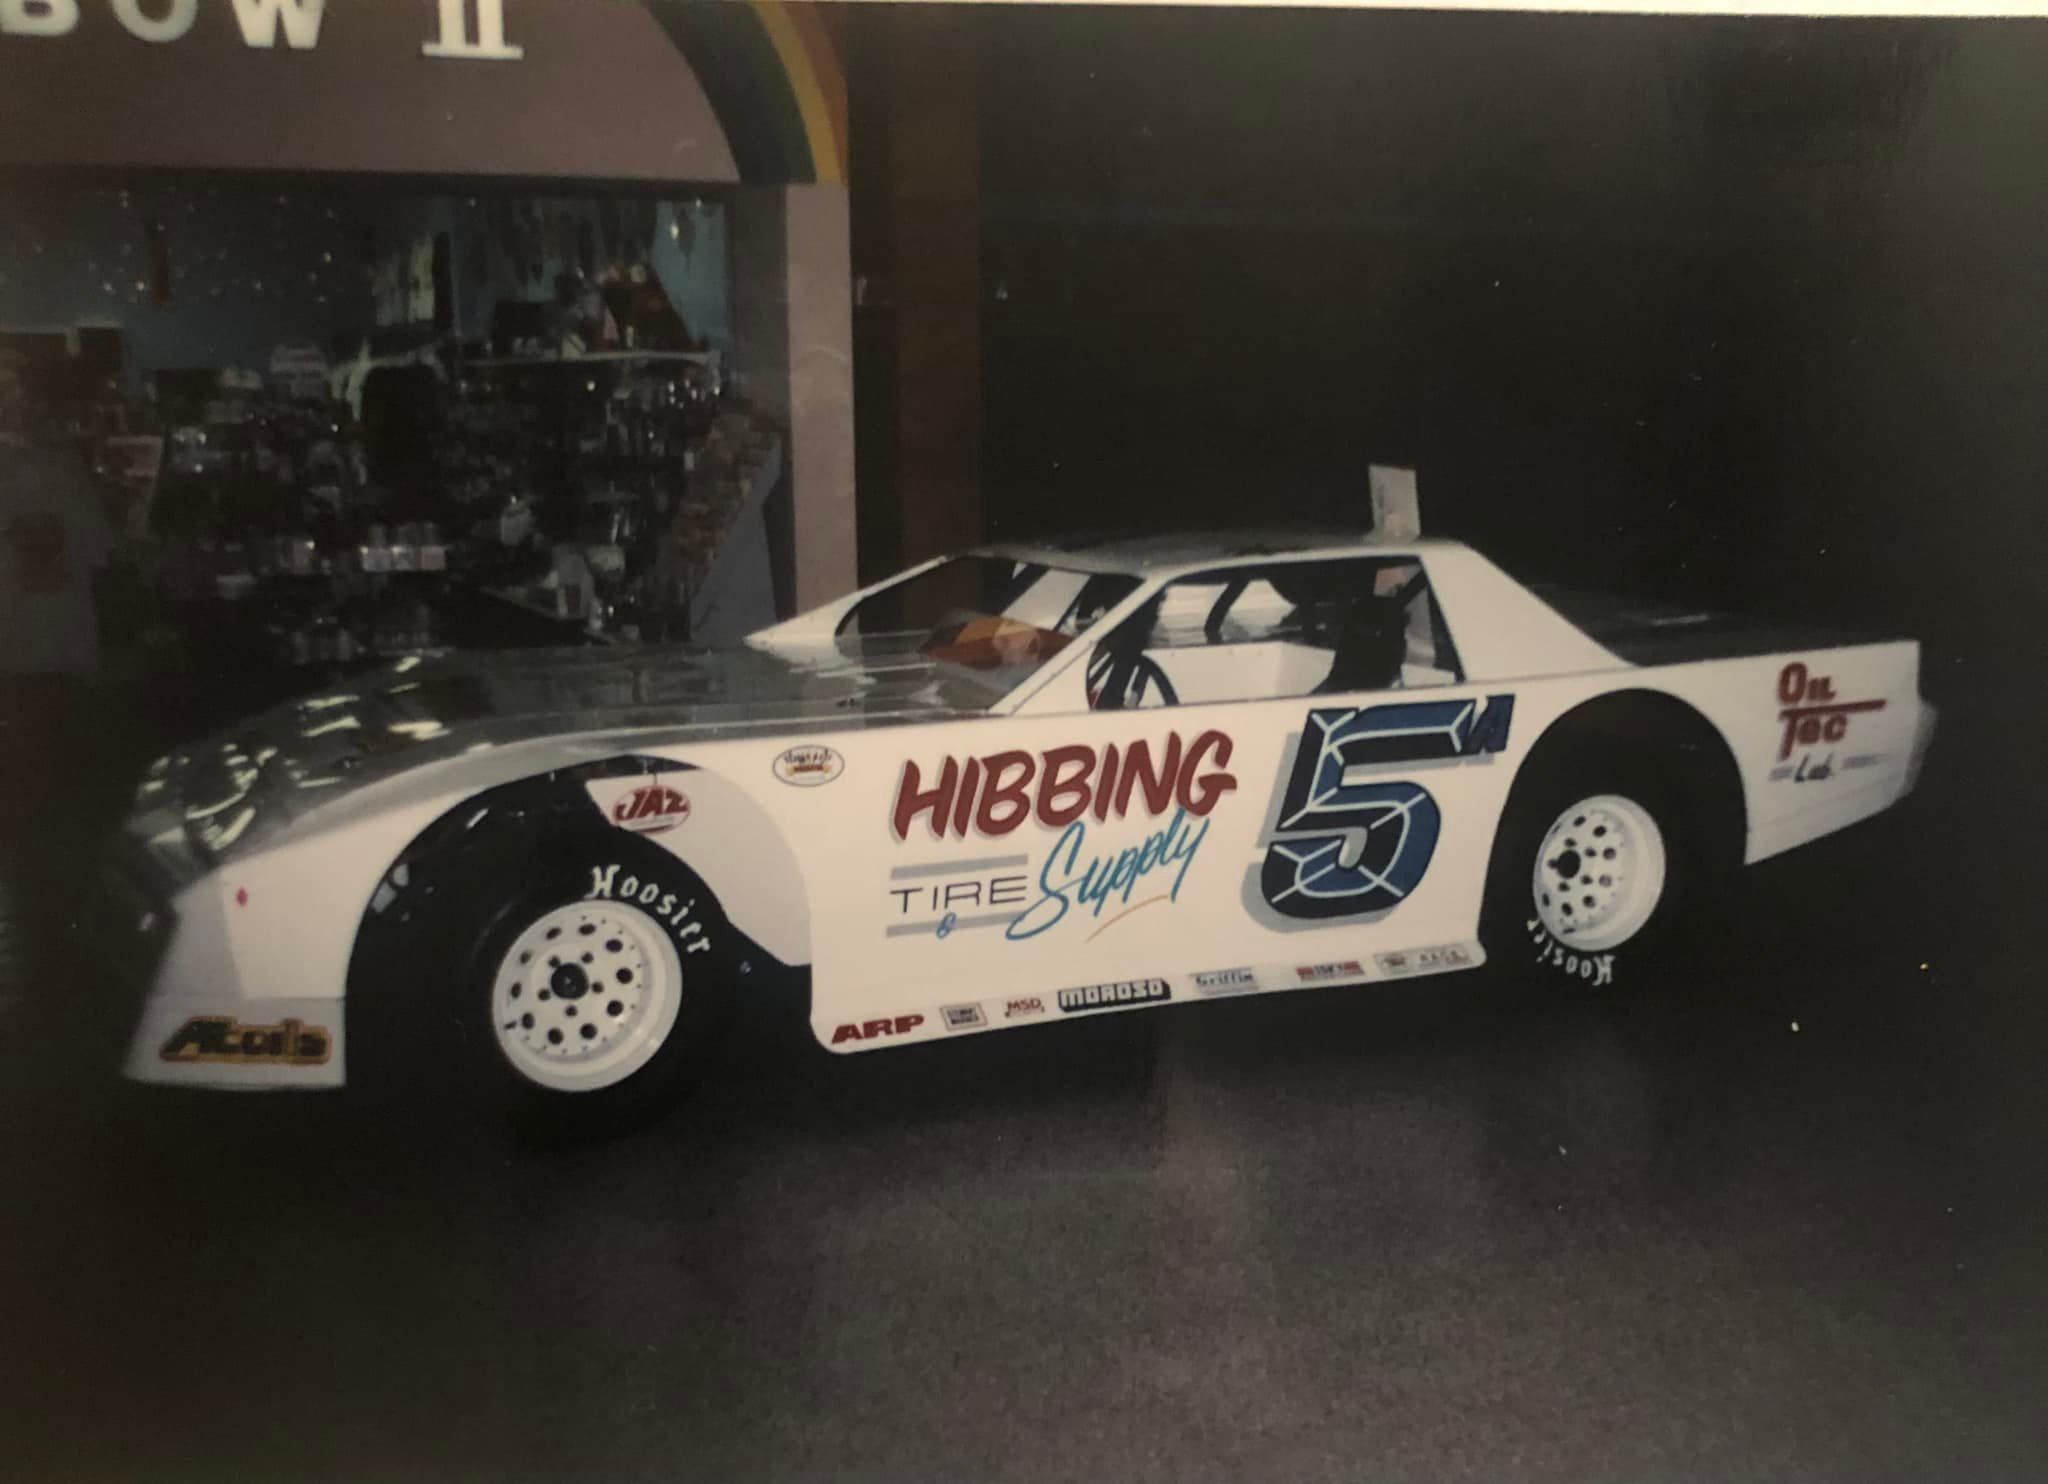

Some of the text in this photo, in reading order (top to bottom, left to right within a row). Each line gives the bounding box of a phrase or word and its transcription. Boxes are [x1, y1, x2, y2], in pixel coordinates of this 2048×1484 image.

[892, 729, 1238, 841] HIBBING
[615, 788, 689, 820] JAZ
[1005, 808, 1210, 941] Supply
[583, 864, 711, 953] Hoosier
[889, 875, 1028, 914] TIRE
[1006, 997, 1042, 1011] MSD
[1059, 979, 1171, 1012] MOROSO
[831, 1014, 925, 1045] ARP
